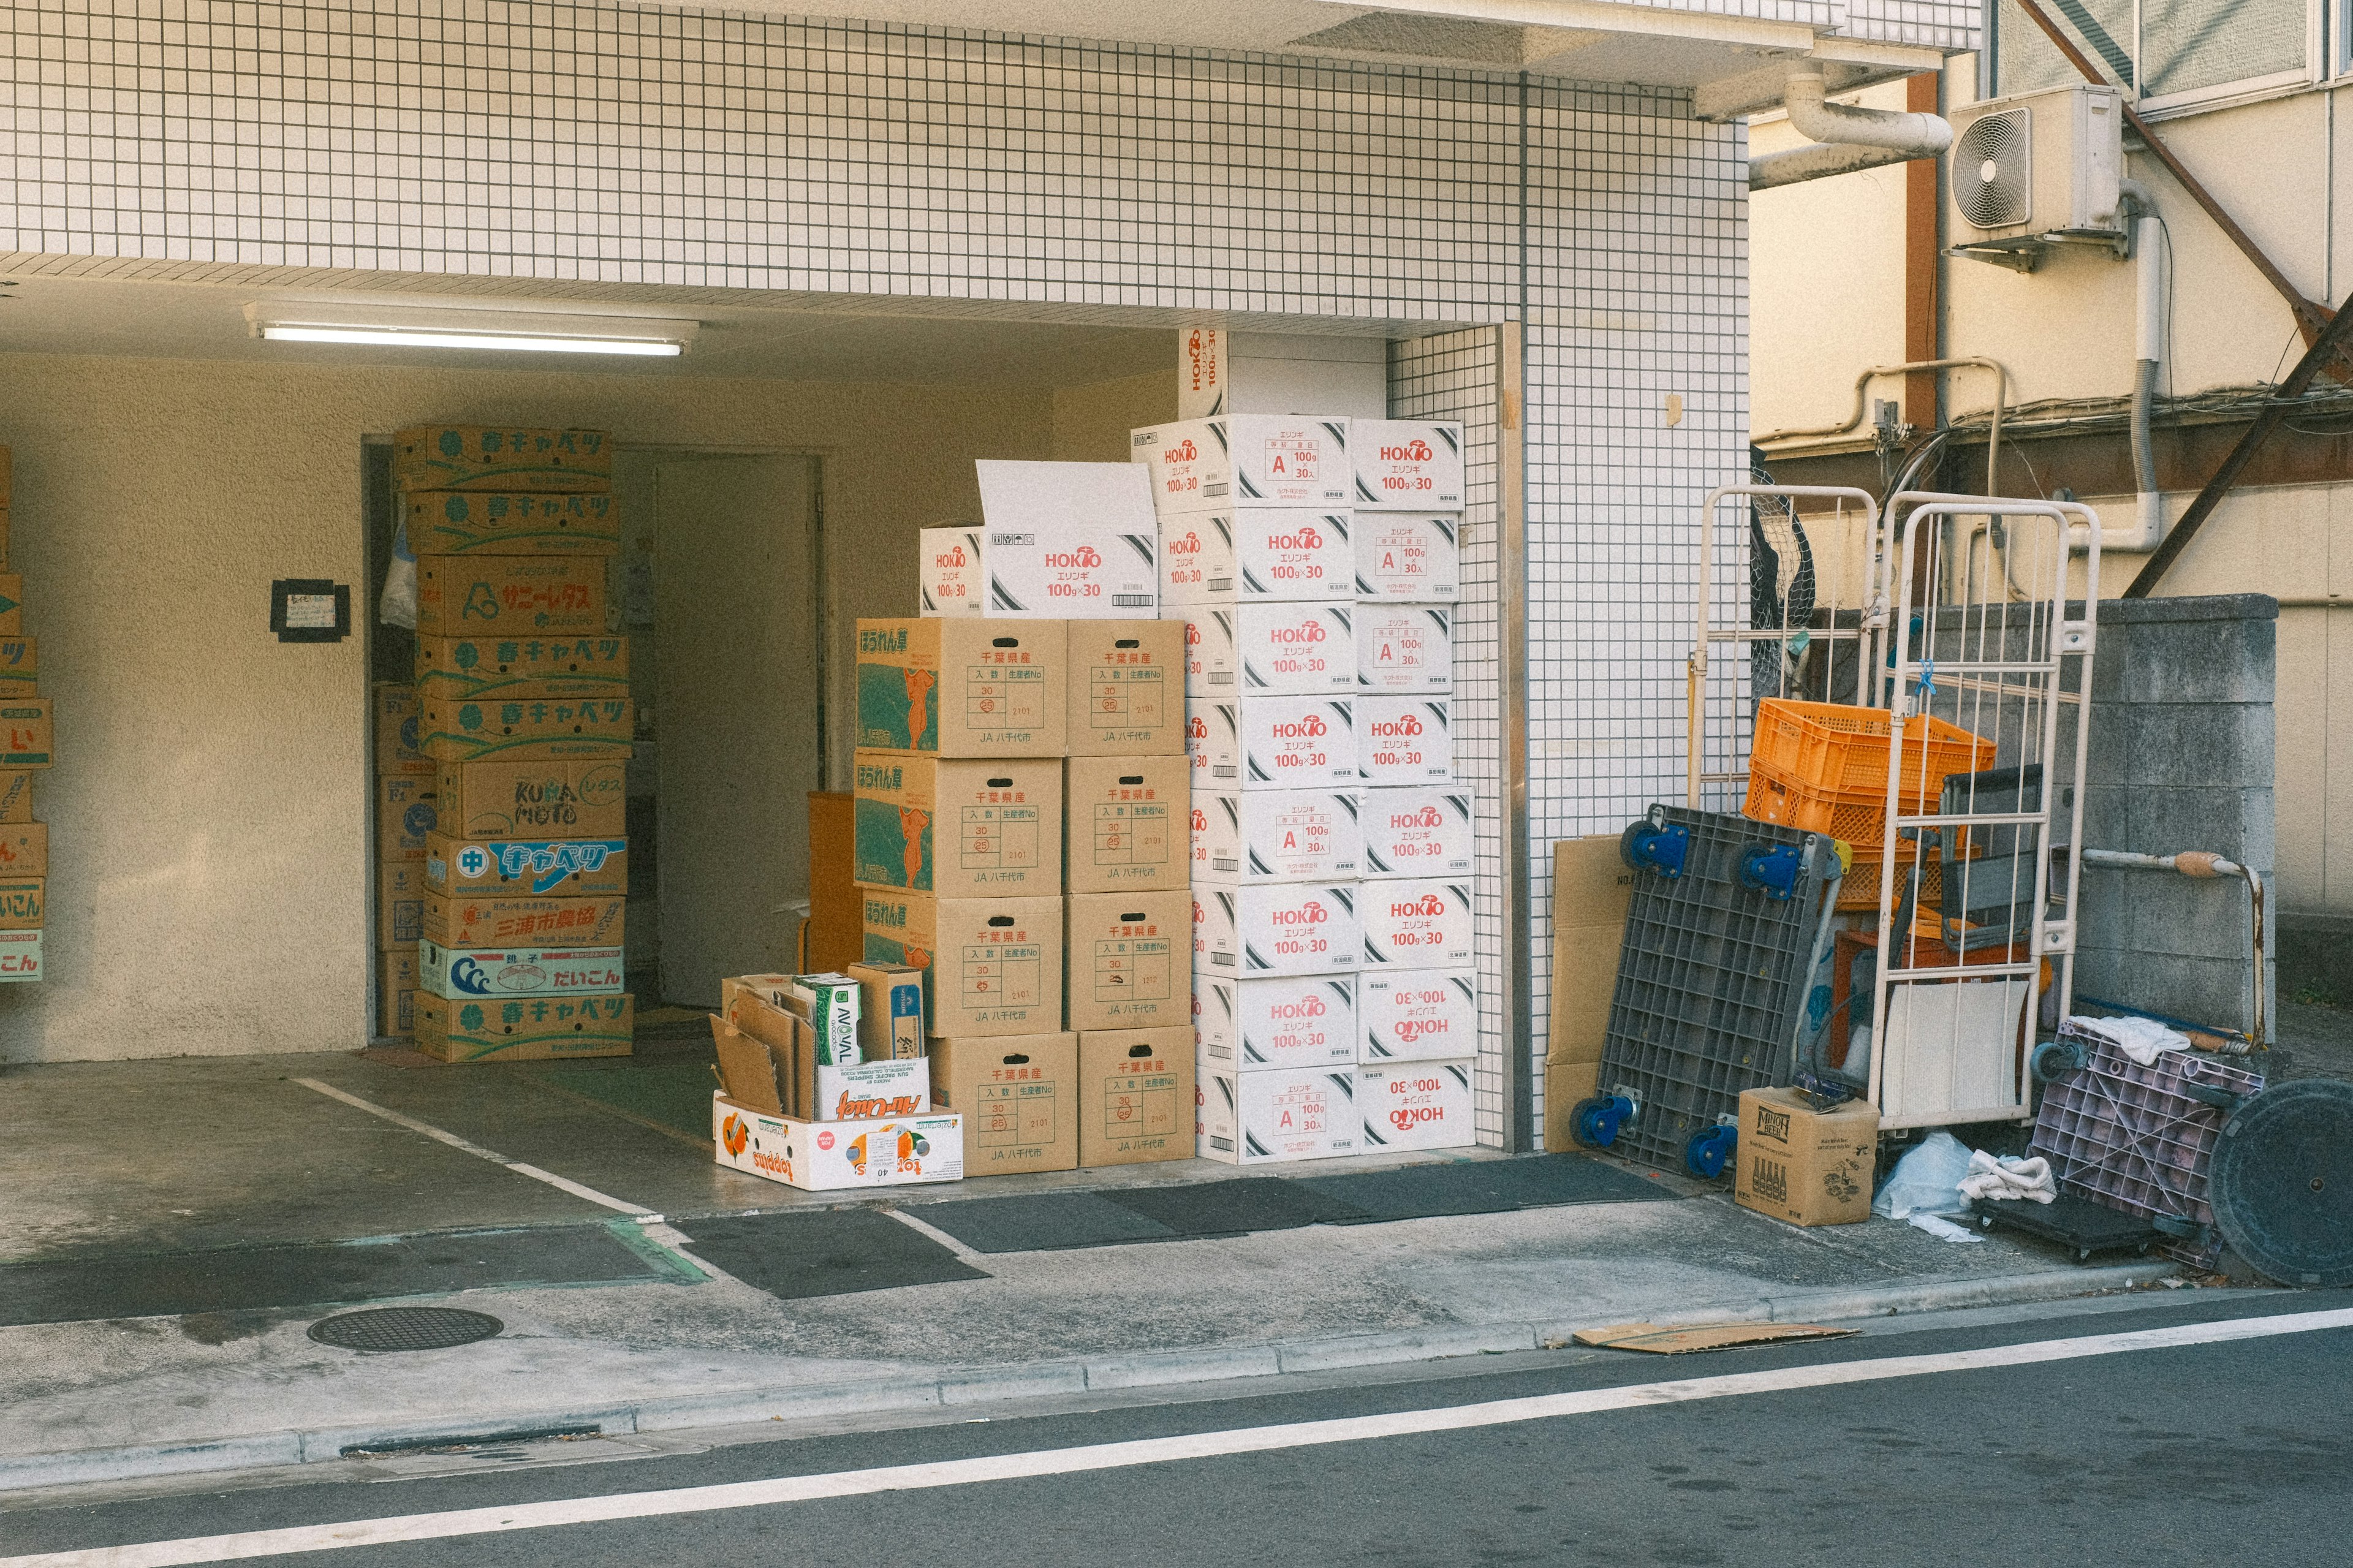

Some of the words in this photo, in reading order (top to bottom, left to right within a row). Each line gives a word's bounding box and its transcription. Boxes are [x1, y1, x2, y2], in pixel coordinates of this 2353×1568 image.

[482, 431, 602, 454] 春キャベツ
[1294, 452, 1316, 462] 100g
[1272, 456, 1285, 472] A
[1172, 466, 1190, 476] エリンギ
[488, 496, 610, 518] 春キャベツ
[1404, 548, 1425, 557] 100g
[1176, 558, 1194, 567] エリンギ
[1382, 552, 1394, 568] A
[942, 572, 960, 581] エリンギ
[502, 584, 590, 610] サニーレタス
[860, 630, 907, 653] ほうれん草
[1401, 640, 1422, 650] 100g
[498, 640, 620, 663] 春キャベツ
[1380, 644, 1392, 660] A
[981, 653, 1031, 663] 千葉県産
[1104, 653, 1151, 664] 千葉県産
[501, 702, 624, 724] 春キャベツ
[980, 733, 991, 742] JA
[996, 732, 1031, 743] 八千代市
[1103, 732, 1115, 741] JA
[1119, 731, 1151, 741] 八千代市
[858, 767, 902, 790] ほうれん草
[585, 779, 621, 792] レタス
[976, 792, 1025, 803] 千葉県産
[1108, 789, 1154, 800] 千葉県産
[1108, 823, 1119, 831] 30
[1305, 826, 1328, 836] 100g
[1108, 838, 1119, 846] 25
[1284, 831, 1296, 848] A
[502, 846, 608, 872] キャベツ
[974, 873, 987, 882] JA
[991, 872, 1025, 882] 八千代市
[1107, 868, 1119, 877] JA
[1123, 867, 1155, 877] 八千代市
[865, 900, 906, 928] ほうれん草
[494, 906, 596, 937] 三浦市農協
[977, 931, 1026, 942] 千葉県産
[1109, 926, 1157, 936] 千葉県産
[554, 971, 620, 986] だいこん
[1012, 990, 1029, 999] 2101
[502, 998, 625, 1023] 春キャベツ
[1108, 1006, 1120, 1015] JA
[1124, 1004, 1156, 1014] 八千代市
[976, 1012, 988, 1021] JA
[992, 1011, 1026, 1021] 八千代市
[1118, 1061, 1164, 1072] 千葉県産
[991, 1069, 1041, 1080] 千葉県産
[993, 1104, 1004, 1113] 30
[1303, 1104, 1324, 1114] 100g
[1280, 1110, 1292, 1128] A
[1757, 1111, 1790, 1137] MINOH
[1765, 1124, 1781, 1137] BEER
